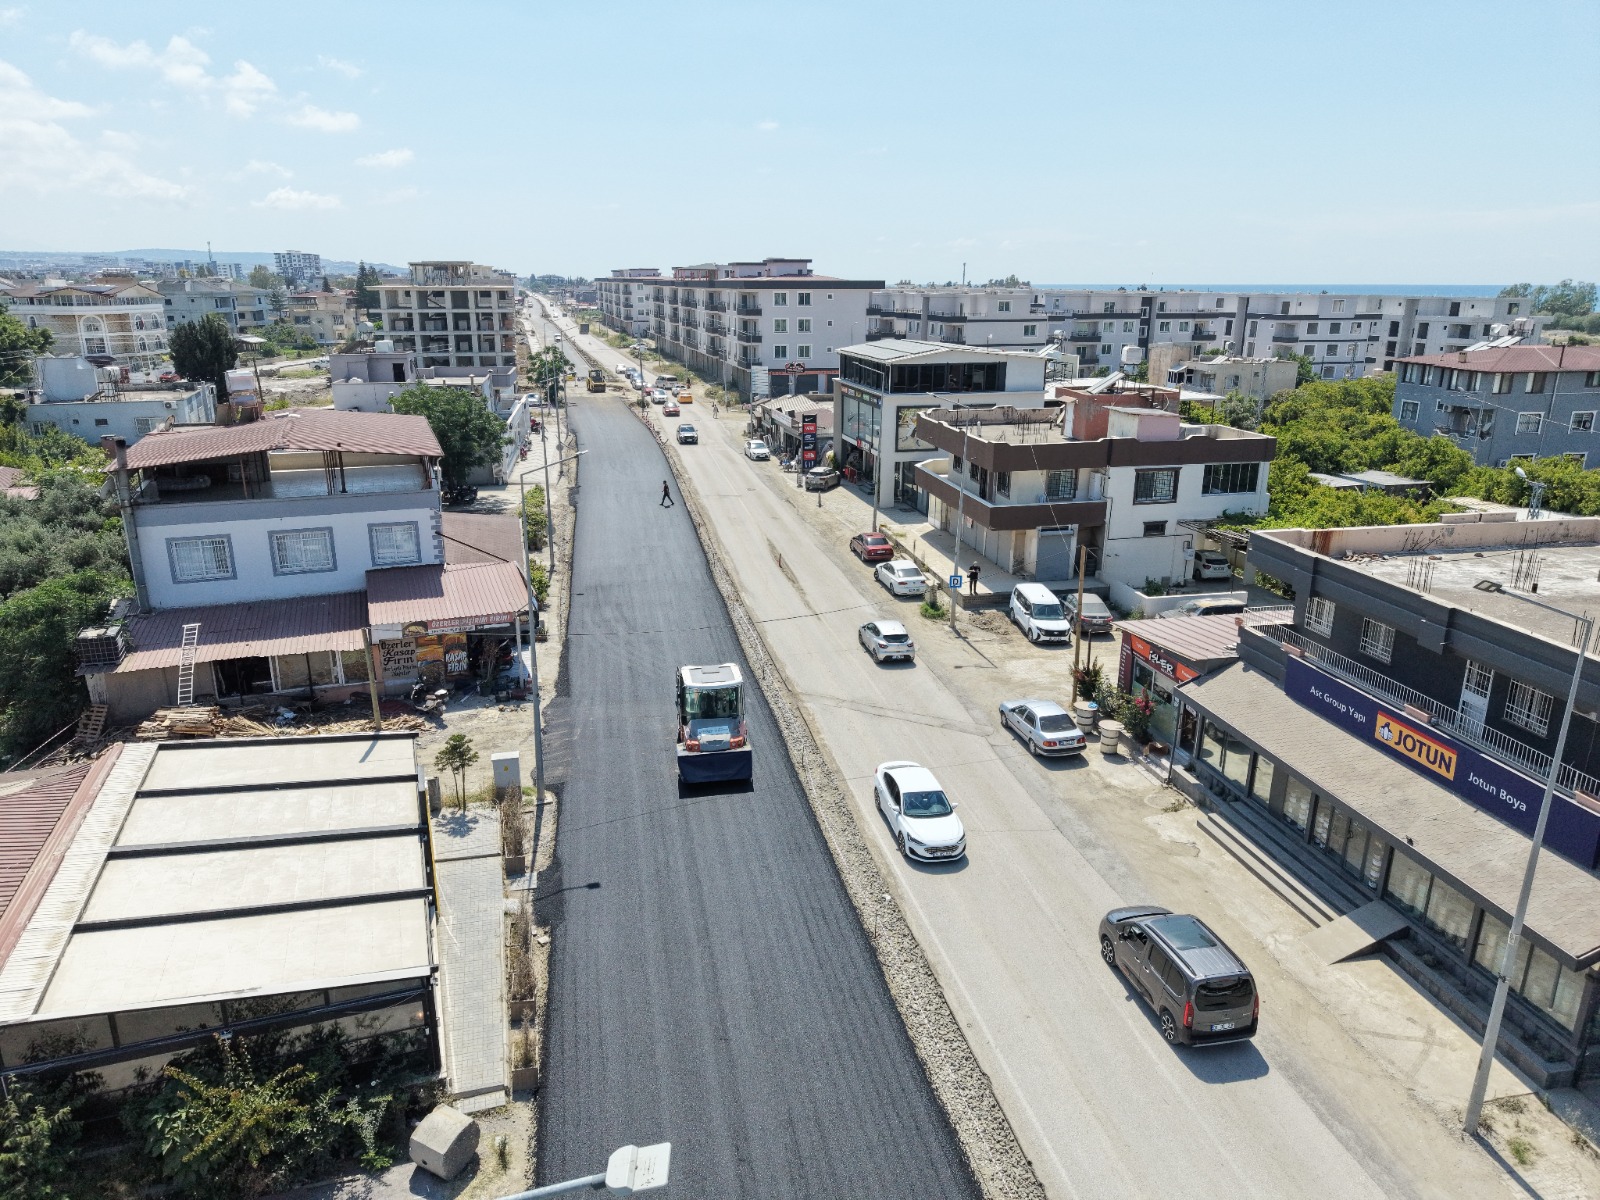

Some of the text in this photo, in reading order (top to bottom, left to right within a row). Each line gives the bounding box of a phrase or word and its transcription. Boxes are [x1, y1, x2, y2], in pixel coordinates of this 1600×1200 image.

[382, 649, 416, 657] Kasap
[445, 651, 467, 663] KASAP
[448, 660, 468, 672] FIRIN
[1309, 685, 1366, 723] Asc Group Yapı
[1394, 729, 1453, 774] JOTUN
[1467, 772, 1527, 812] Jotun Boya
